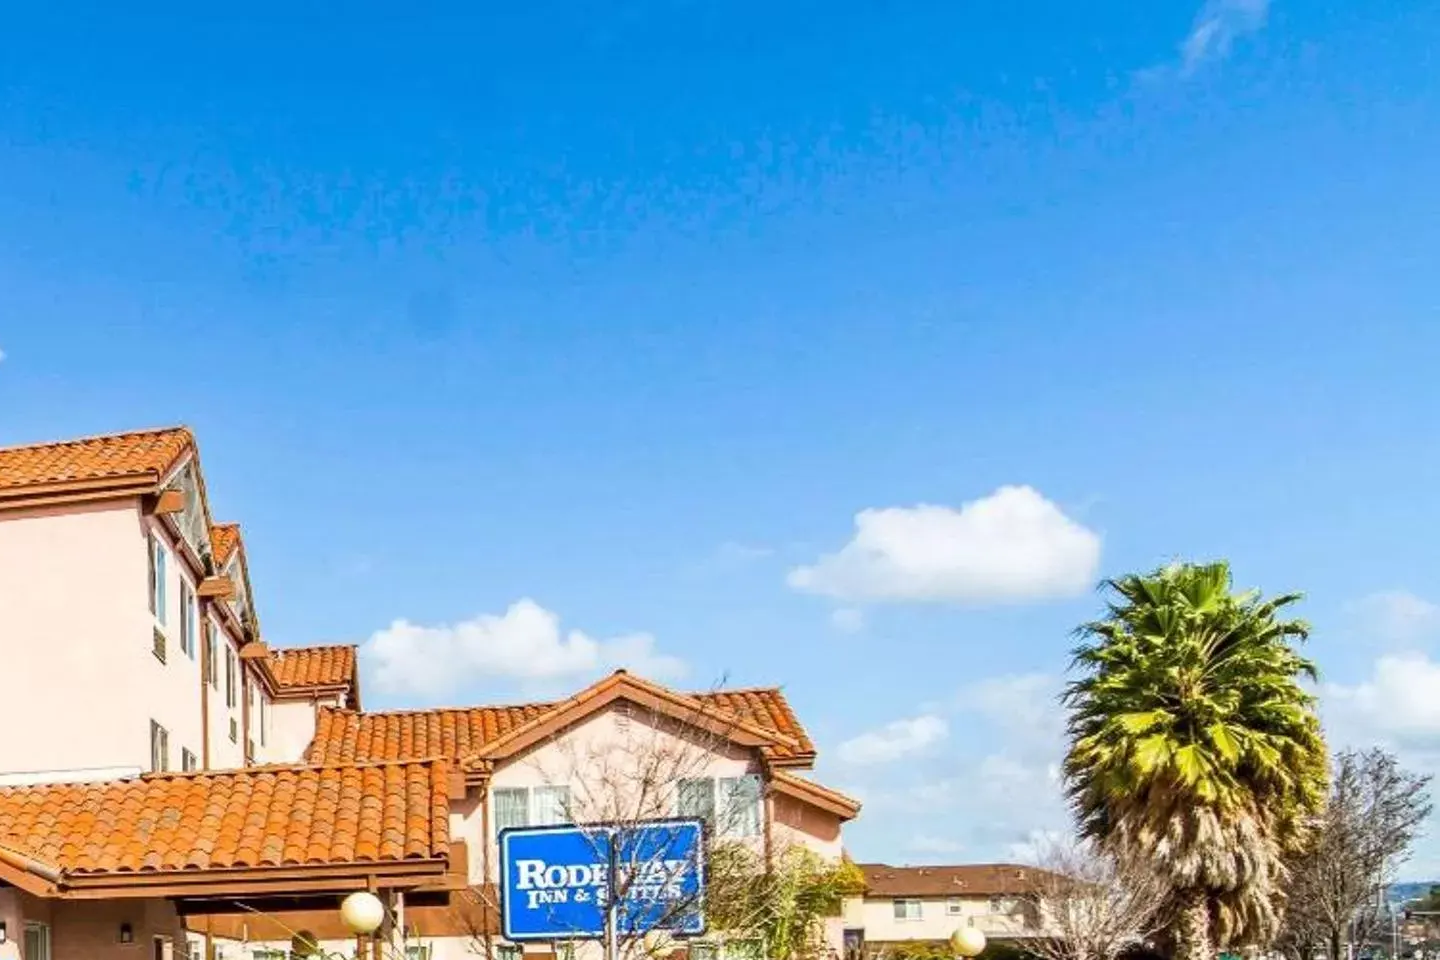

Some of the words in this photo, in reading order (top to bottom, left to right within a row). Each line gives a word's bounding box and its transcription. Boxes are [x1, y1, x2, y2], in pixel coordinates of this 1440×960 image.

[515, 859, 689, 890] RODEAY
[527, 889, 569, 909] INN
[573, 888, 591, 903] &
